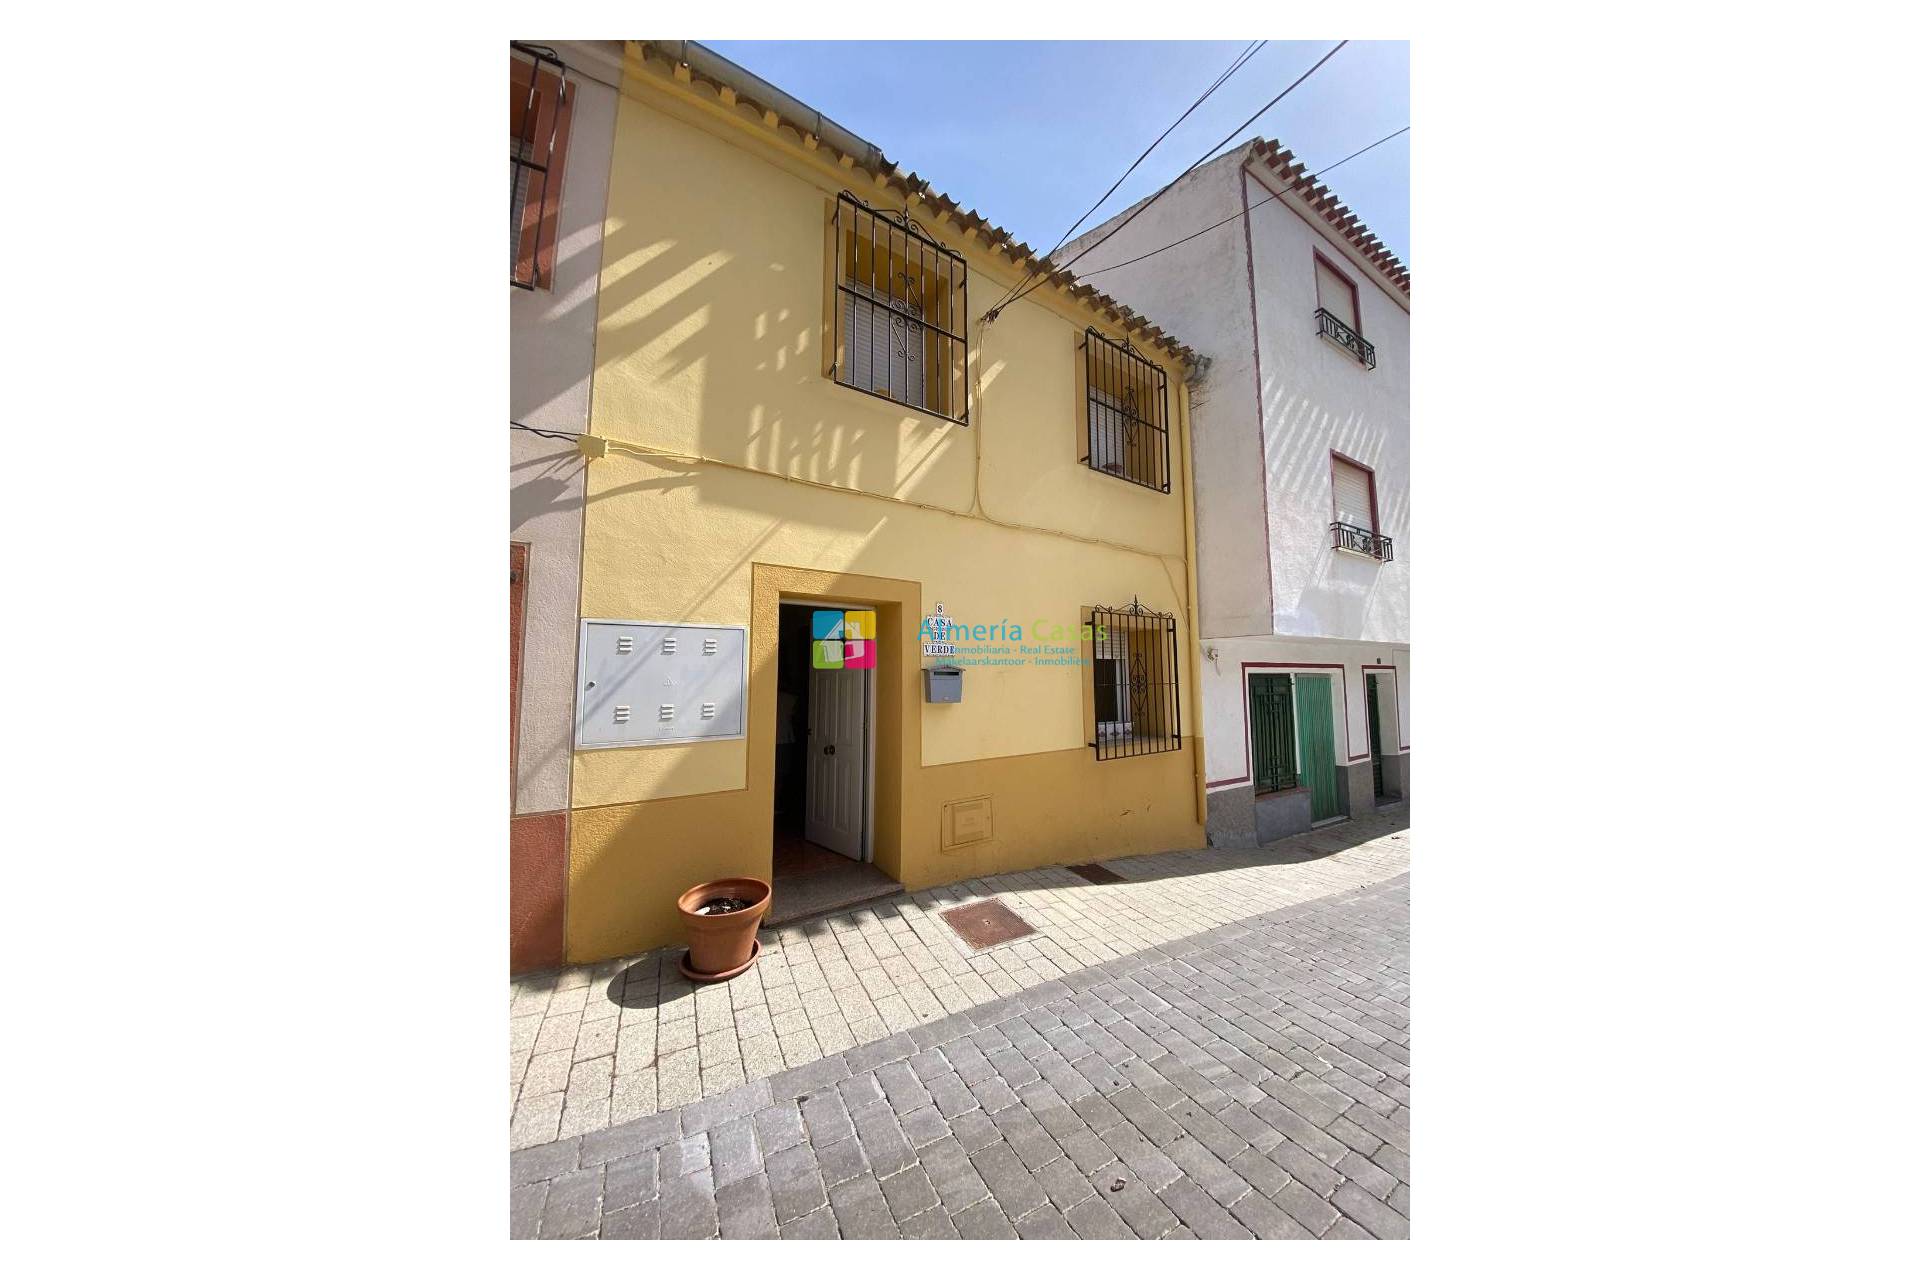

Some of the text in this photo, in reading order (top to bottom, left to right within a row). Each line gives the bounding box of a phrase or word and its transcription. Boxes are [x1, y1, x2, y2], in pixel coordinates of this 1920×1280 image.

[937, 604, 943, 614] 8
[927, 617, 953, 628] CASA
[934, 631, 946, 641] DE
[924, 644, 955, 655] VERDE
